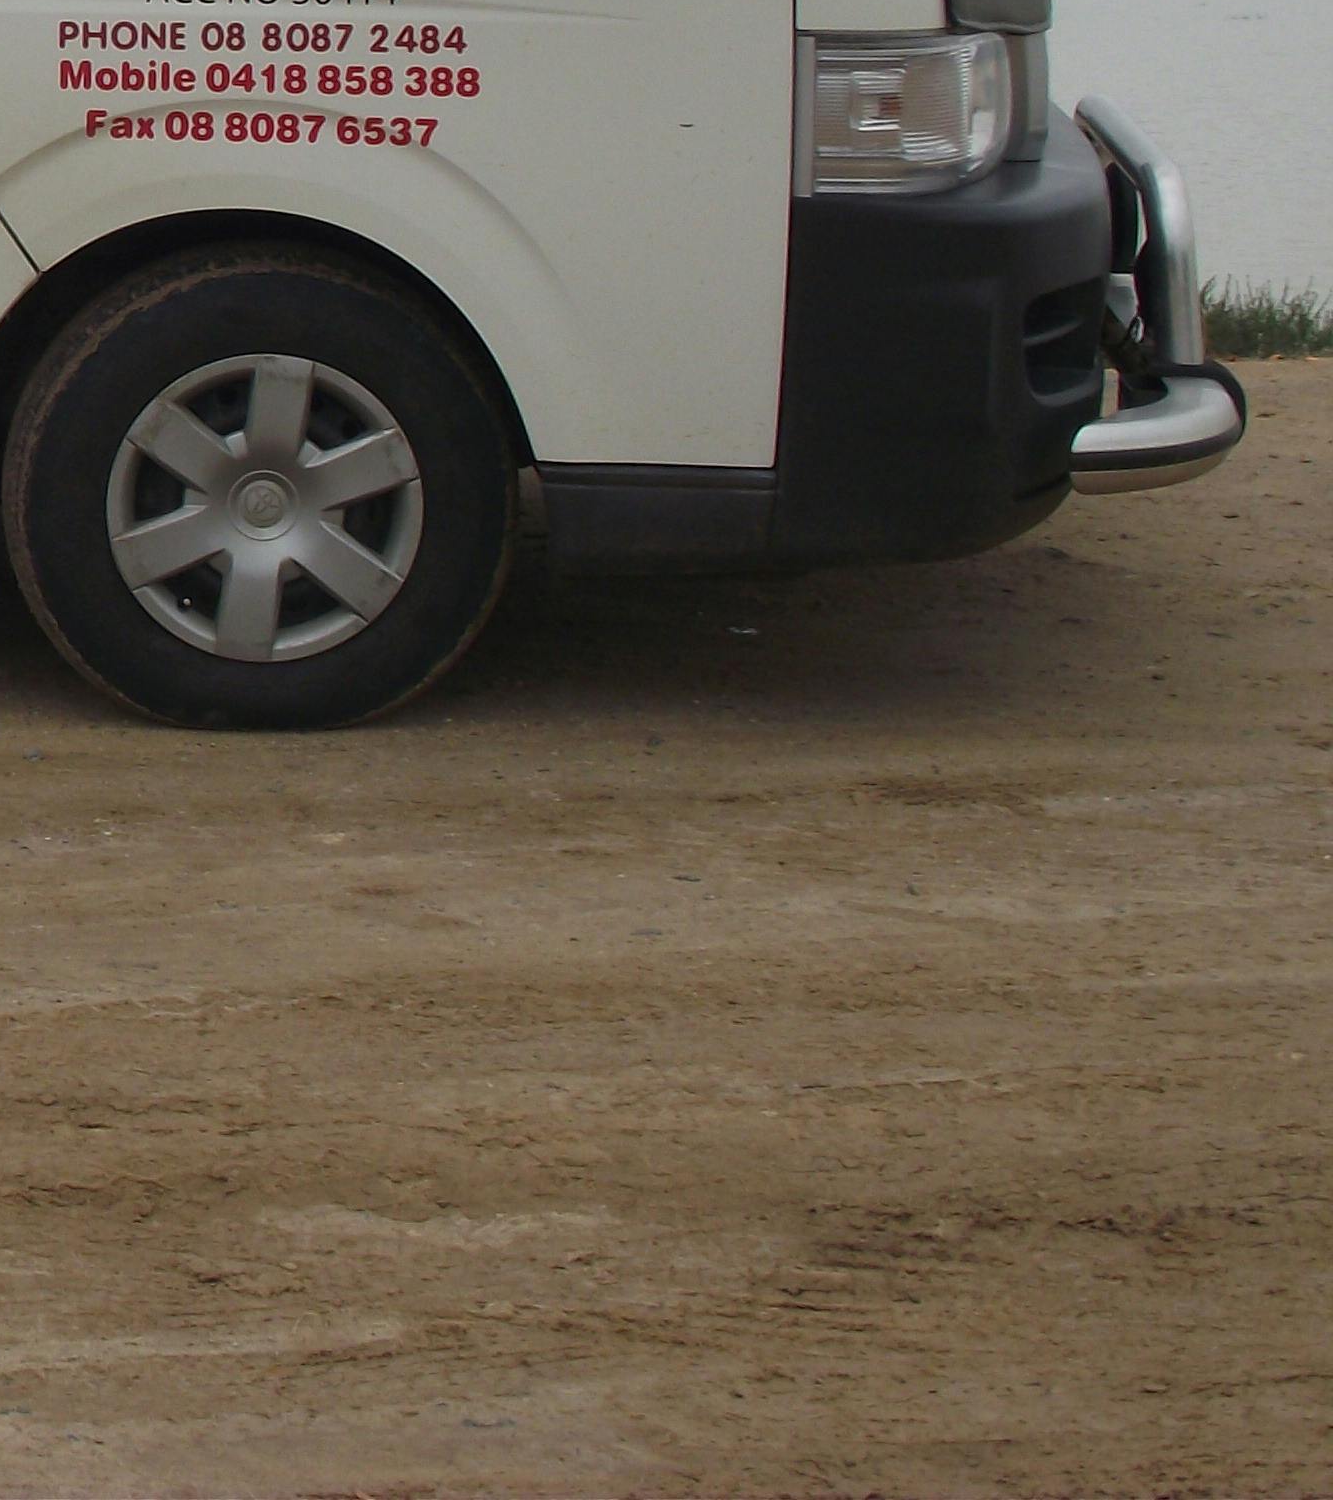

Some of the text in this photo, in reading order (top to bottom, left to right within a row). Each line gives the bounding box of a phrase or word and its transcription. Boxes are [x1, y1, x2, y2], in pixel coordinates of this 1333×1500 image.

[58, 21, 468, 54] PHONE 08 8087 2484
[59, 60, 481, 98] Mobile 0418 858 388
[85, 109, 439, 147] Fax 08 8087 6537
